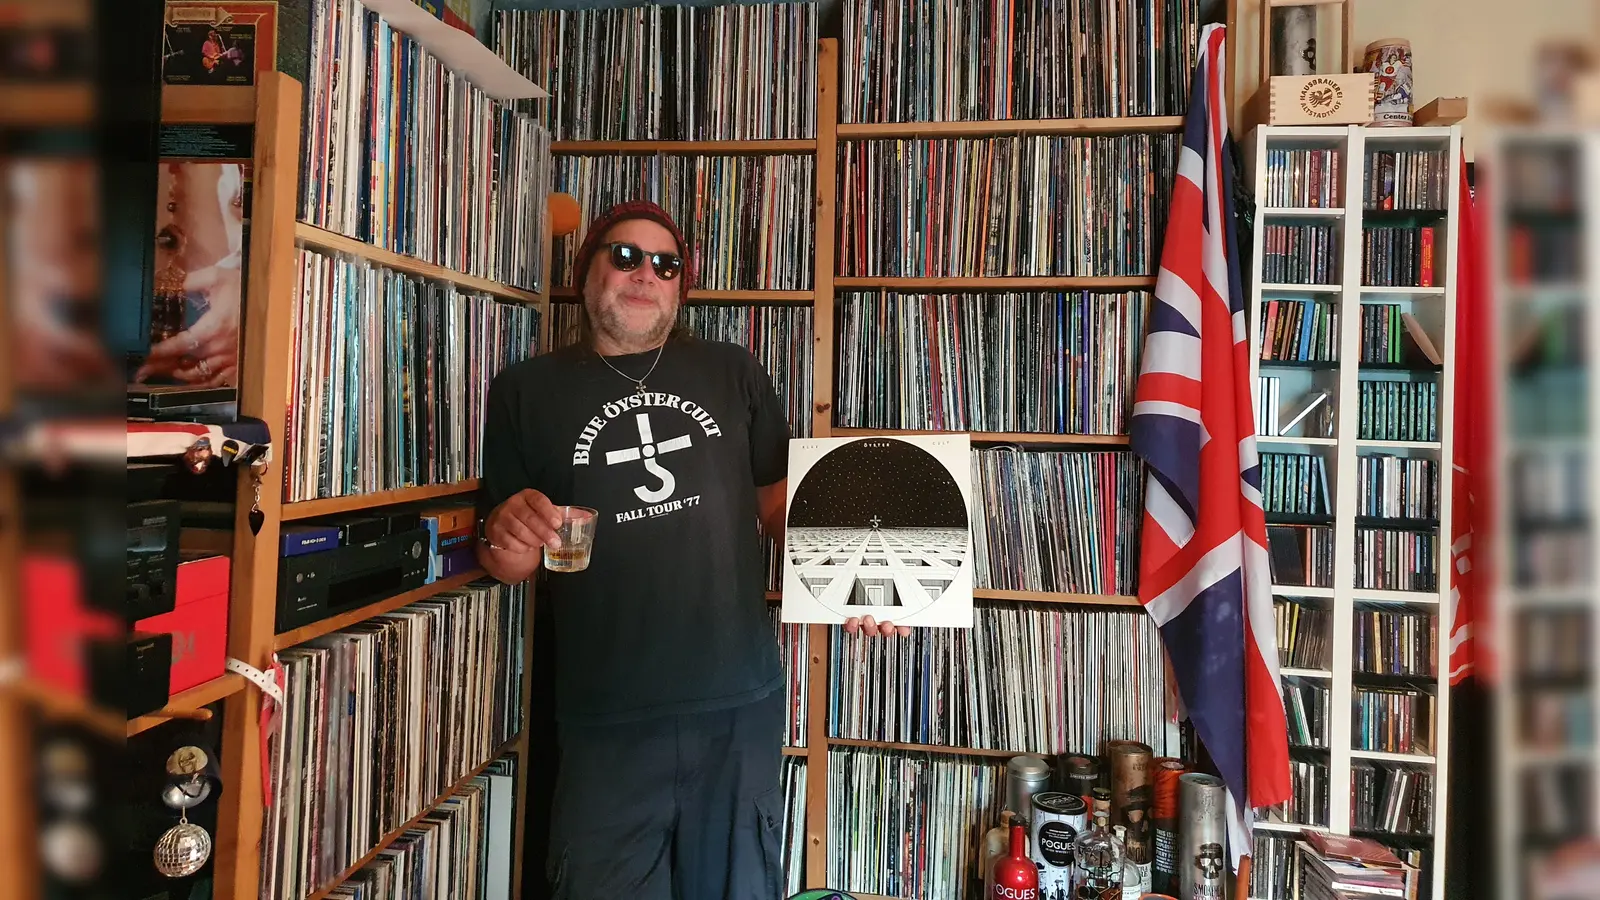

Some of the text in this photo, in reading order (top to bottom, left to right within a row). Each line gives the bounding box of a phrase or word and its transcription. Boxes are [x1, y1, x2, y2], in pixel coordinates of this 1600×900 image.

[1299, 78, 1343, 101] HAUSBRAUEREI
[1300, 101, 1342, 119] ALTSTADTHOF
[572, 391, 722, 467] BLUE ÖYSTER CULT
[615, 505, 645, 523] FALL
[645, 500, 682, 515] TOUR
[1041, 837, 1077, 851] POGUES
